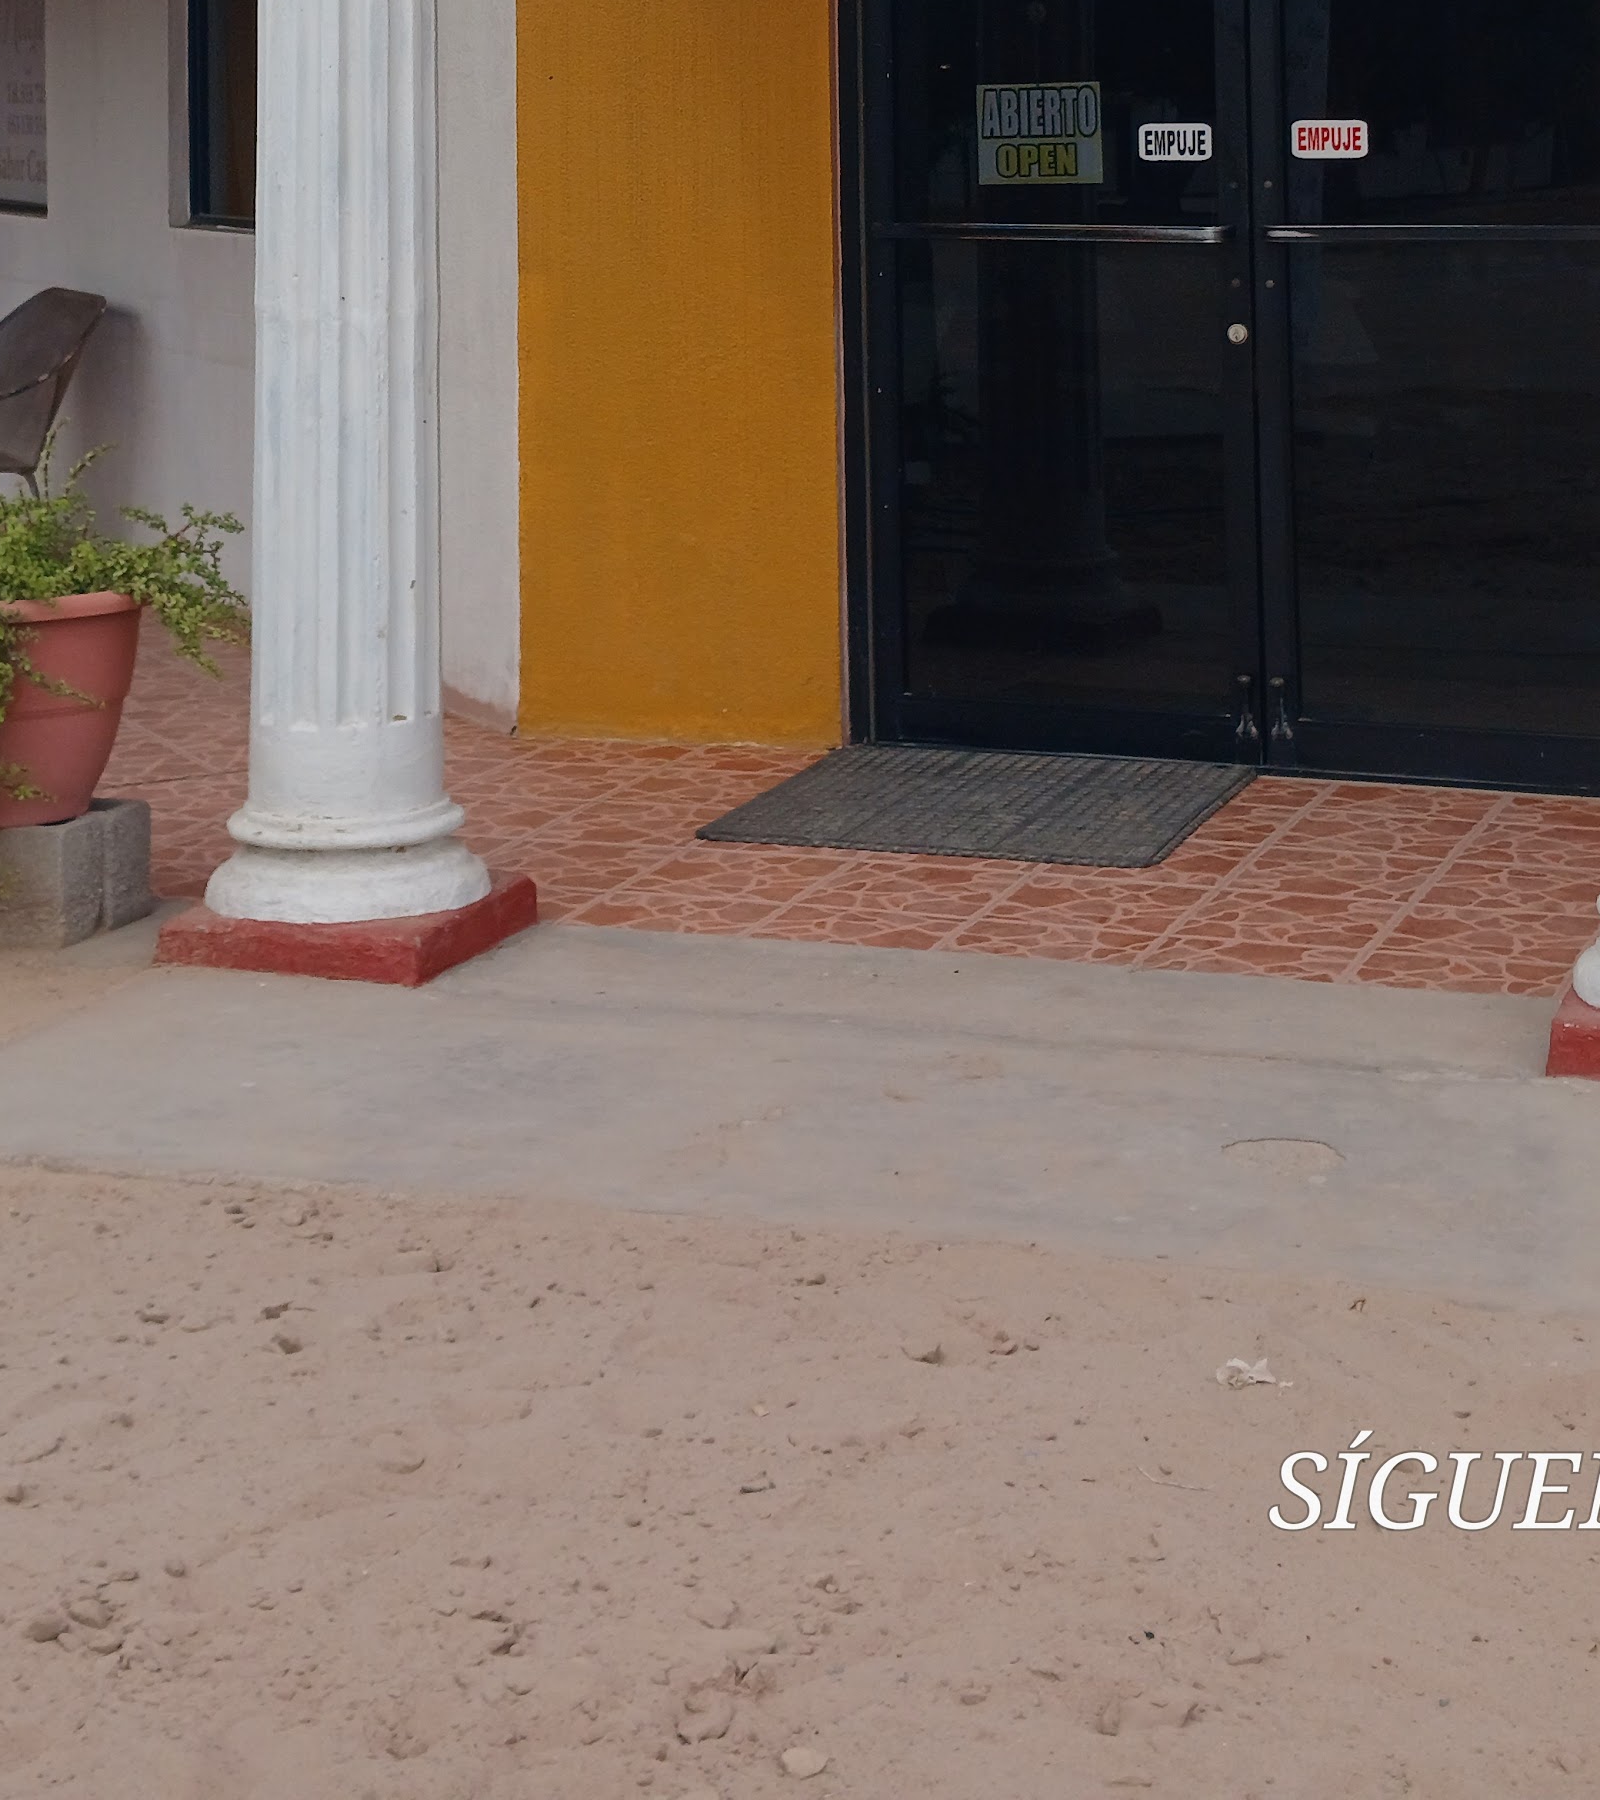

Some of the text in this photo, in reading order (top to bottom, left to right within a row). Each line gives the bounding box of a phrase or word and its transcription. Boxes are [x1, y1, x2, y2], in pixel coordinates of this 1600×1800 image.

[982, 85, 1097, 139] ABIERTO
[1144, 129, 1207, 156] EMPUJE
[1298, 126, 1361, 151] EMPUJE
[996, 143, 1078, 178] OPEN
